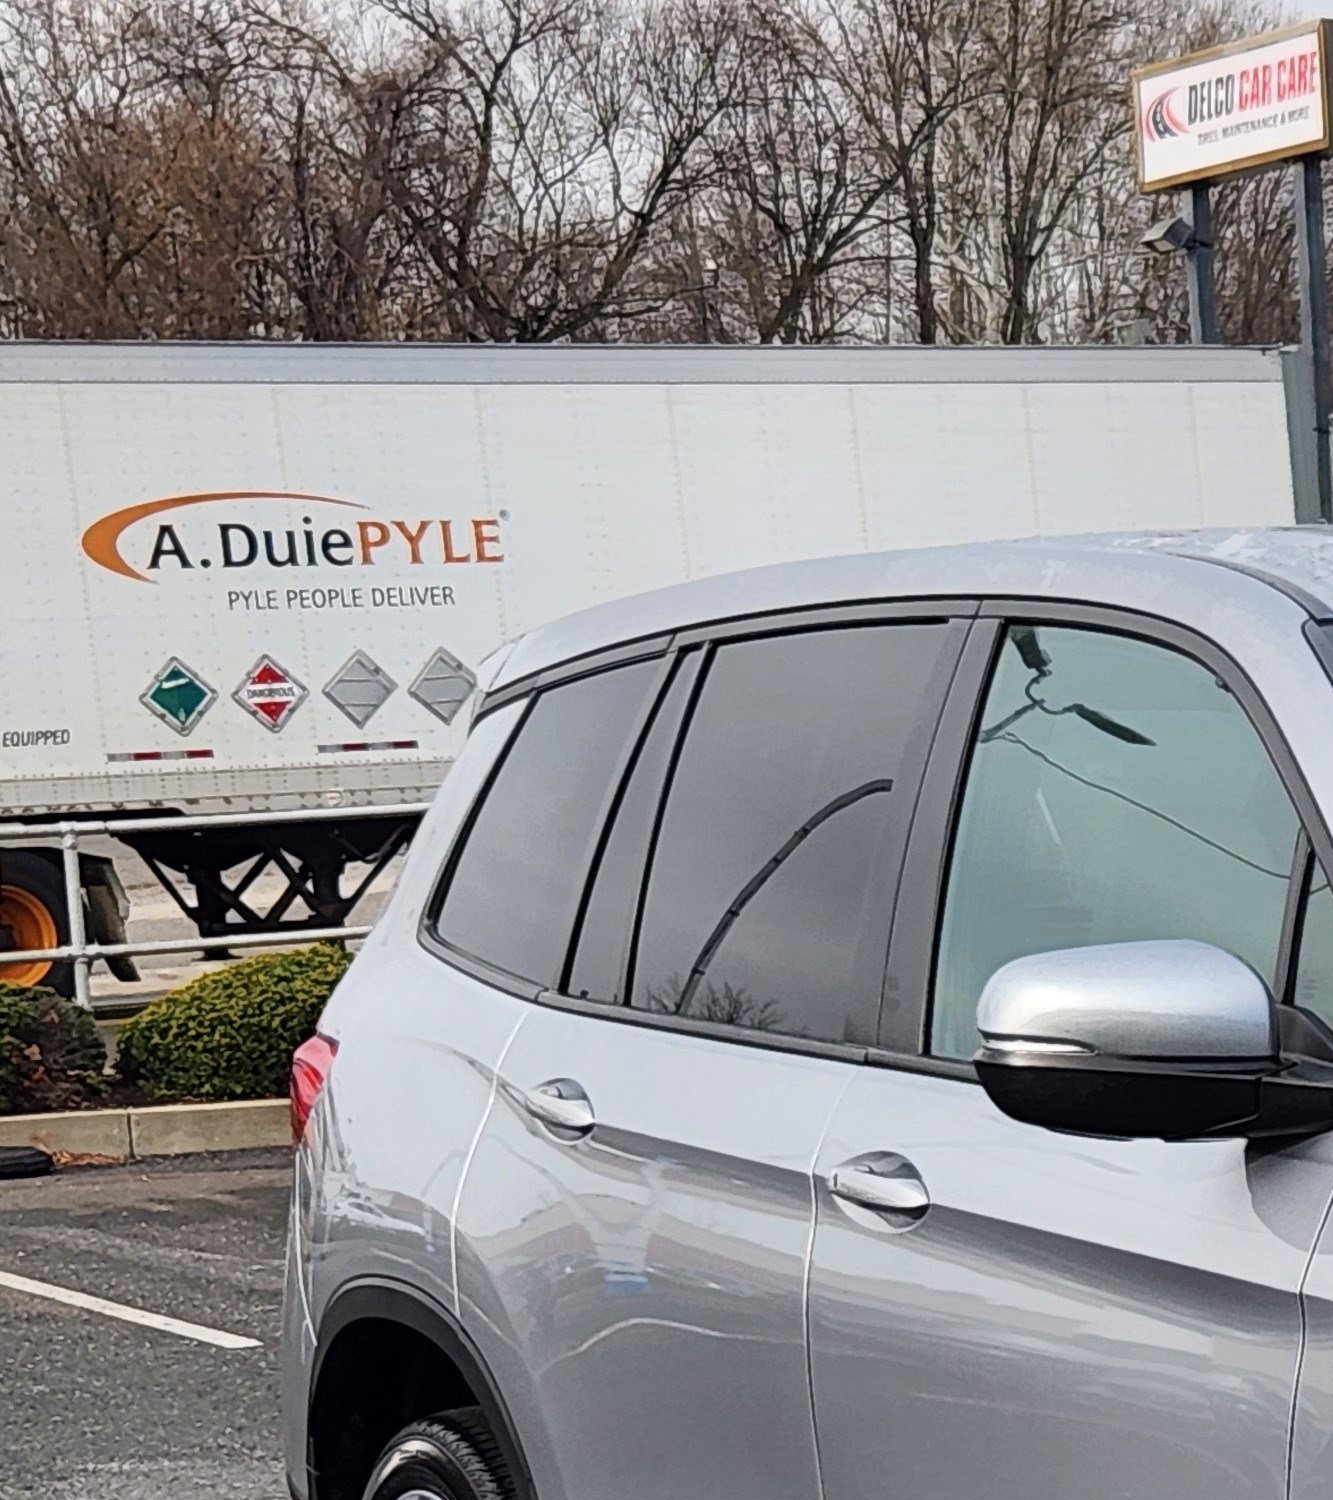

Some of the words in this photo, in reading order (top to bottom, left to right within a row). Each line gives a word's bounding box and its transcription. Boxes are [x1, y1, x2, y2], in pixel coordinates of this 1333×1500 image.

[1188, 74, 1236, 126] DELCO
[1238, 64, 1272, 112] CAR
[1276, 51, 1318, 103] CARE
[228, 590, 278, 610] PYLE
[286, 588, 363, 609] PEOPLE
[372, 585, 456, 608] DELIVER
[2, 729, 71, 748] EQUIPPED
